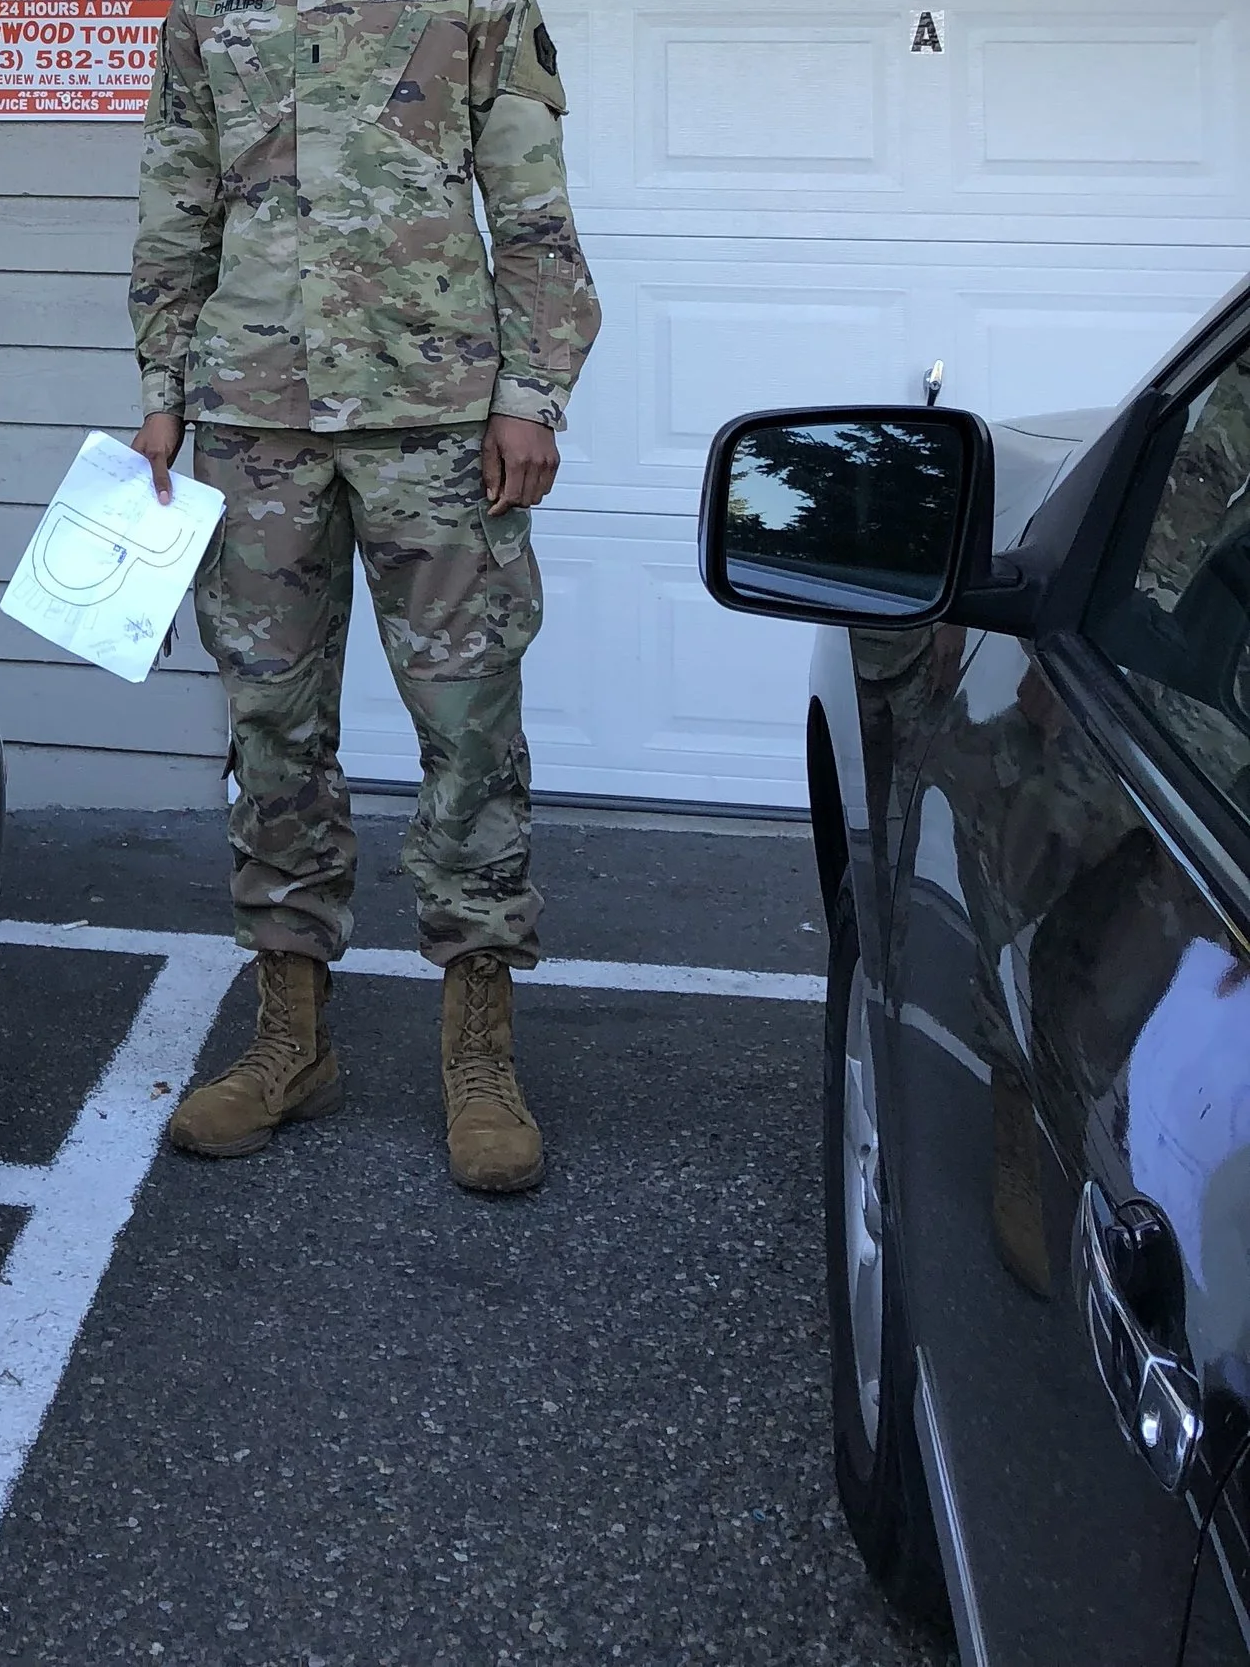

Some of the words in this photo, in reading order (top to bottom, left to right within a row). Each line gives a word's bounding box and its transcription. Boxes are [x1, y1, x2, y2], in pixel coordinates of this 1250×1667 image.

[0, 2, 19, 16] 24
[24, 2, 79, 16] HOURS
[85, 1, 96, 15] A
[101, 1, 133, 15] DAY
[910, 11, 943, 52] A
[38, 74, 64, 85] AVE.
[68, 74, 91, 85] S.W.
[35, 99, 99, 110] UNLOCKS
